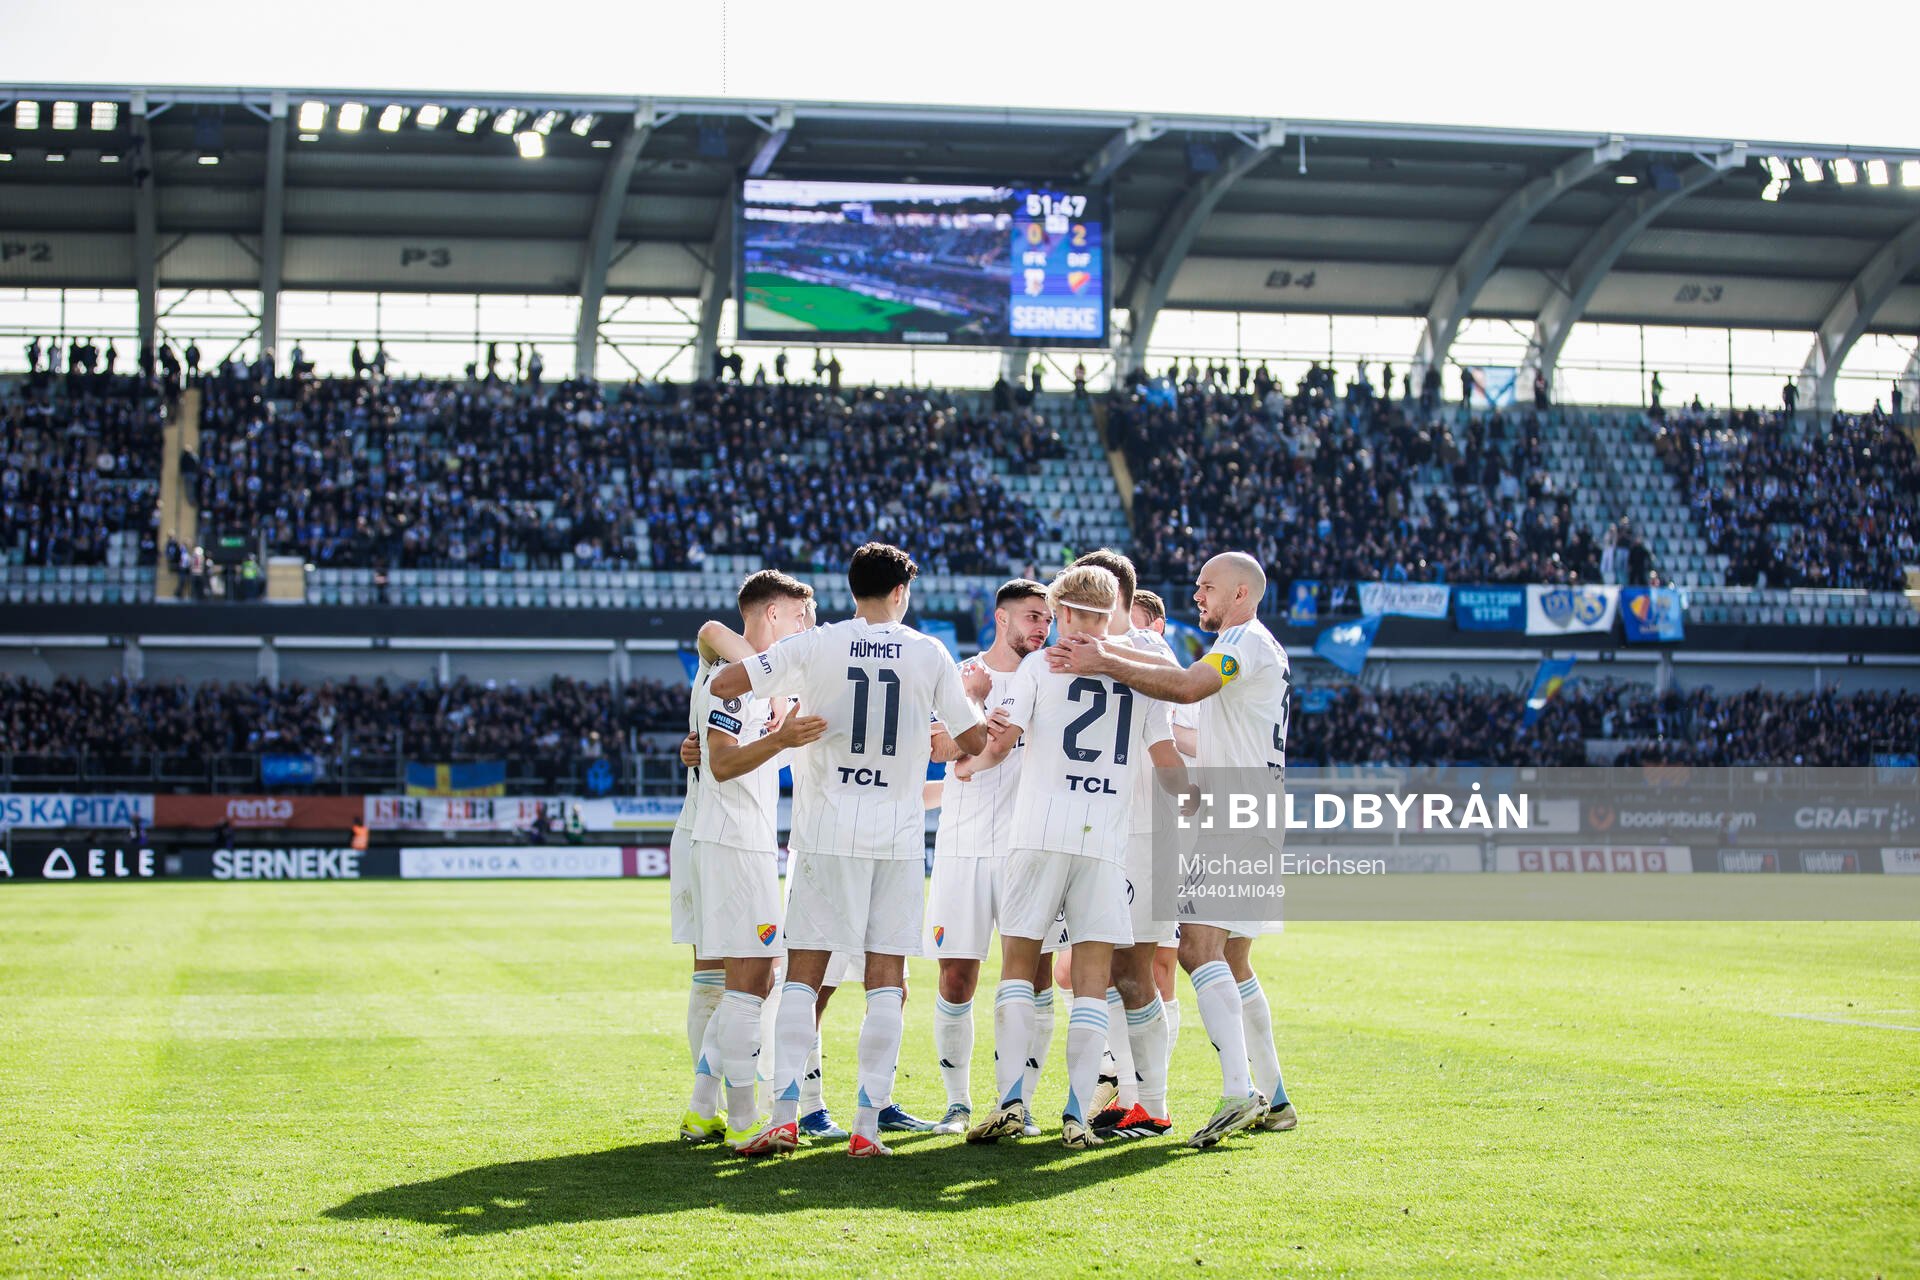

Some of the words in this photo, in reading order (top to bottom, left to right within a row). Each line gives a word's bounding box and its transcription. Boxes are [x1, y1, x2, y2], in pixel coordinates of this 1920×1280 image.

[1027, 223, 1042, 245] 0
[1072, 224, 1087, 246] 2
[401, 248, 452, 268] P3
[1012, 306, 1097, 331] SERNEKE
[850, 639, 902, 659] HÜMMET
[712, 712, 741, 730] UNIBET
[847, 666, 901, 756] 11
[1063, 677, 1133, 765] 21
[838, 766, 888, 788] TCL
[1066, 775, 1117, 795] TCL
[226, 798, 294, 820] renta
[1795, 807, 1889, 830] CRAFT
[212, 849, 360, 879] SERNEKE
[441, 856, 520, 870] VINGA
[1522, 851, 1666, 873] CRAMO
